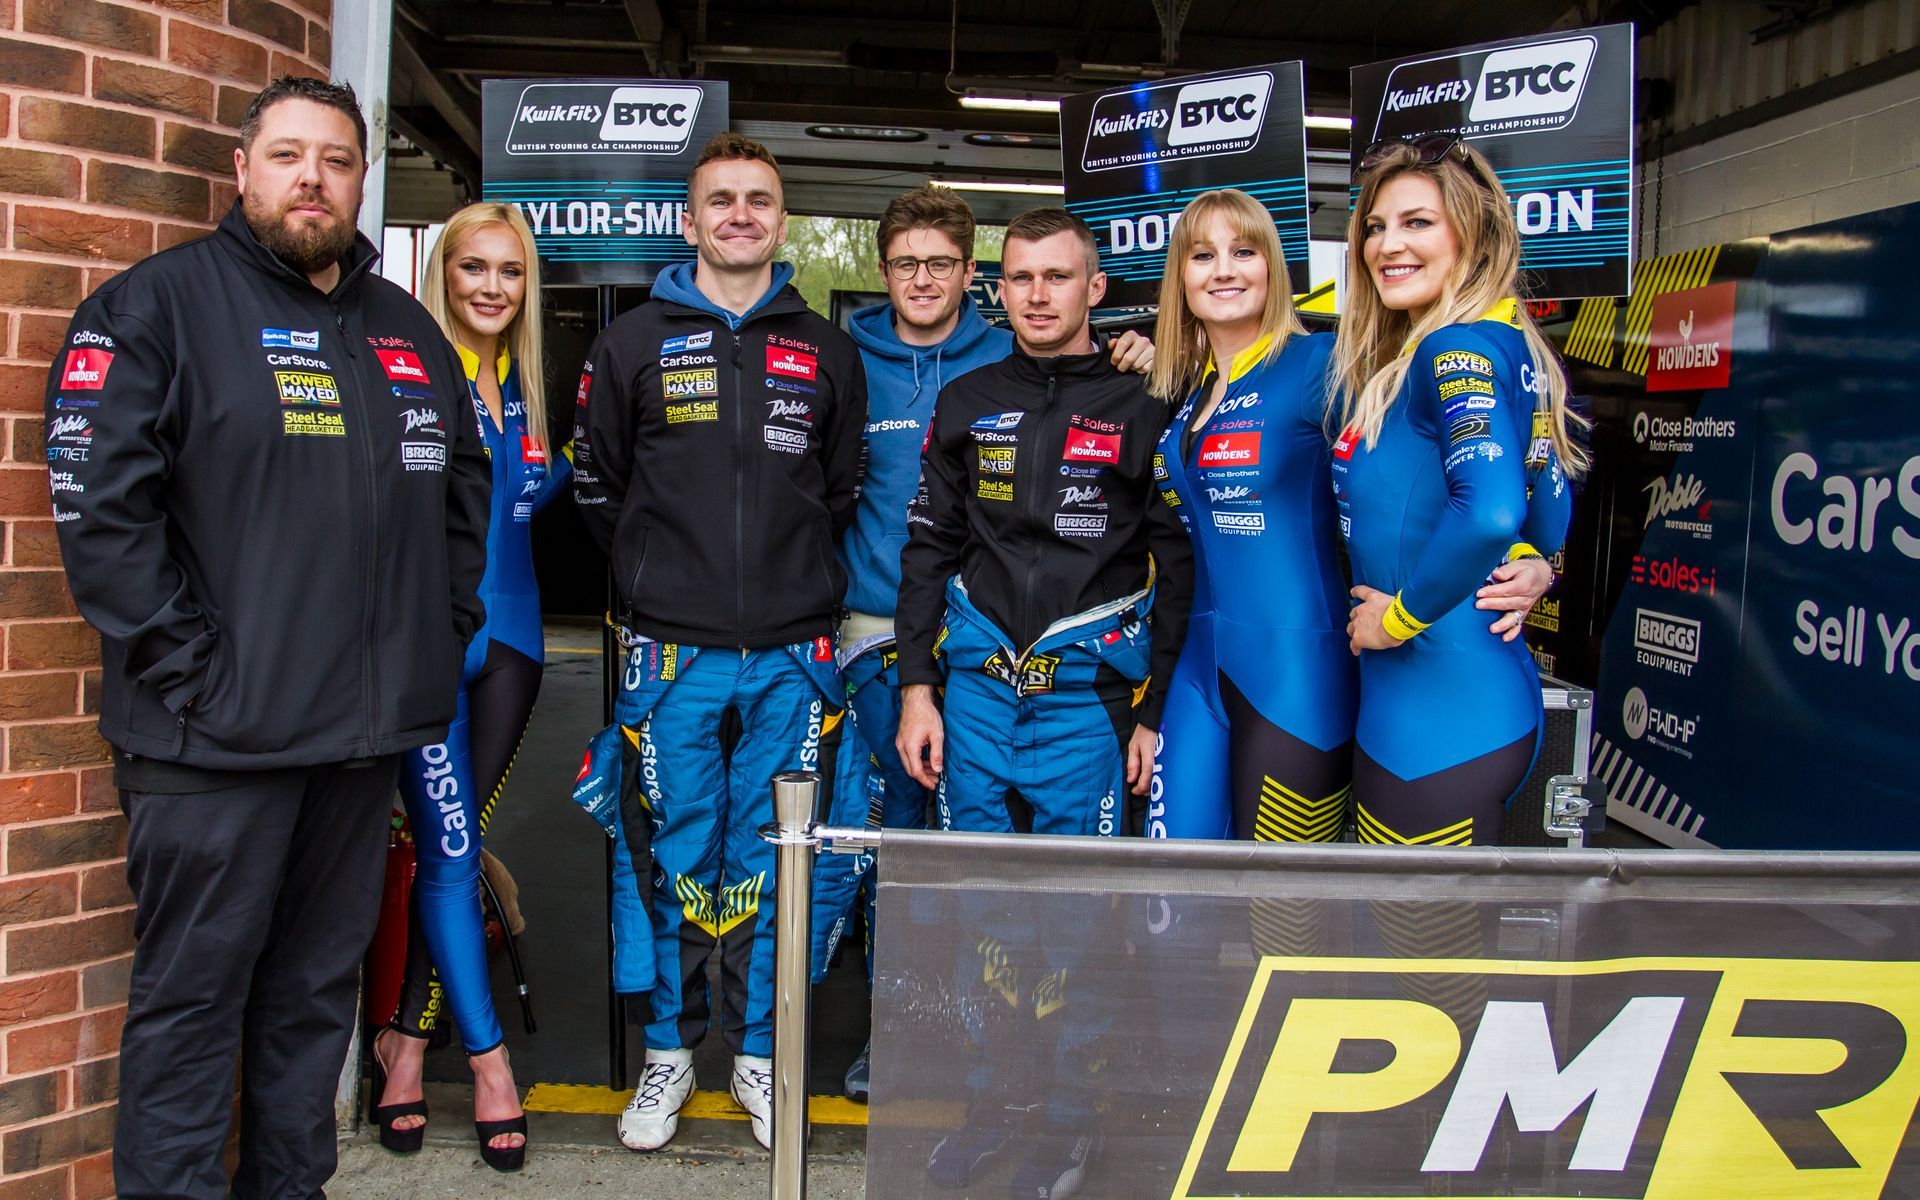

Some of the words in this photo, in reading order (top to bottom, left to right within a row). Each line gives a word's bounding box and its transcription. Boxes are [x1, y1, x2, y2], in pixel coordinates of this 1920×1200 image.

[1485, 61, 1576, 102] BTCC
[613, 103, 688, 127] BTCC
[1180, 93, 1257, 128] BTCC
[1460, 125, 1480, 135] CAR
[1483, 115, 1566, 132] CHAMPIONSHIP
[511, 143, 547, 151] BRITISH
[612, 143, 680, 151] CHAMPIONSHIP
[1086, 156, 1119, 168] BRITISH
[1121, 152, 1158, 163] TOURING
[1160, 149, 1178, 158] CAR
[1180, 140, 1250, 155] CHAMPIONSHIP
[1507, 188, 1594, 236] ON
[779, 337, 818, 354] sales-i
[1436, 352, 1489, 366] POWER
[1657, 342, 1720, 371] HOWDENS
[388, 365, 423, 377] HOWDENS
[772, 361, 810, 374] HOWDENS
[280, 374, 332, 389] POWER
[665, 372, 713, 384] POWER
[1439, 377, 1467, 394] Steel
[1468, 377, 1492, 390] Seal
[282, 385, 337, 401] MAXED
[666, 381, 713, 394] MAXED
[666, 404, 692, 416] Steel
[693, 402, 717, 412] Seal
[766, 399, 810, 419] Doble
[284, 412, 315, 425] Steel
[317, 413, 344, 426] Seal
[868, 419, 920, 433] arStore.
[1083, 418, 1124, 432] sales-i
[1220, 418, 1265, 430] sales-i
[1650, 417, 1681, 437] Close
[1683, 417, 1736, 437] Brothers
[767, 429, 806, 445] BRIGGS
[405, 446, 444, 460] BRIGGS
[768, 444, 804, 454] EQUIPMENT
[1071, 446, 1112, 458] HOWDENS
[1650, 440, 1668, 452] Motor
[1669, 441, 1694, 453] Finance
[980, 450, 1012, 461] POWER
[1203, 449, 1251, 461] HOWDENS
[980, 459, 1012, 473] MAXED
[979, 480, 997, 492] Steel
[998, 482, 1013, 493] Seal
[1203, 485, 1252, 504] Doble
[1642, 472, 1707, 530] Doble
[1057, 517, 1104, 528] BRIGGS
[1215, 514, 1261, 526] BRIGGS
[1665, 520, 1712, 533] MOTORCYCLES
[1218, 528, 1262, 537] EQUIPMENT
[1649, 556, 1716, 597] sales-i
[1542, 597, 1559, 617] Seal
[1638, 619, 1696, 653] BRIGGS
[1793, 599, 1866, 667] Sell
[660, 656, 670, 681] Steel
[1637, 650, 1693, 677] EQUIPMENT
[421, 742, 469, 858] CarSto
[1226, 996, 1908, 1172] PMR
